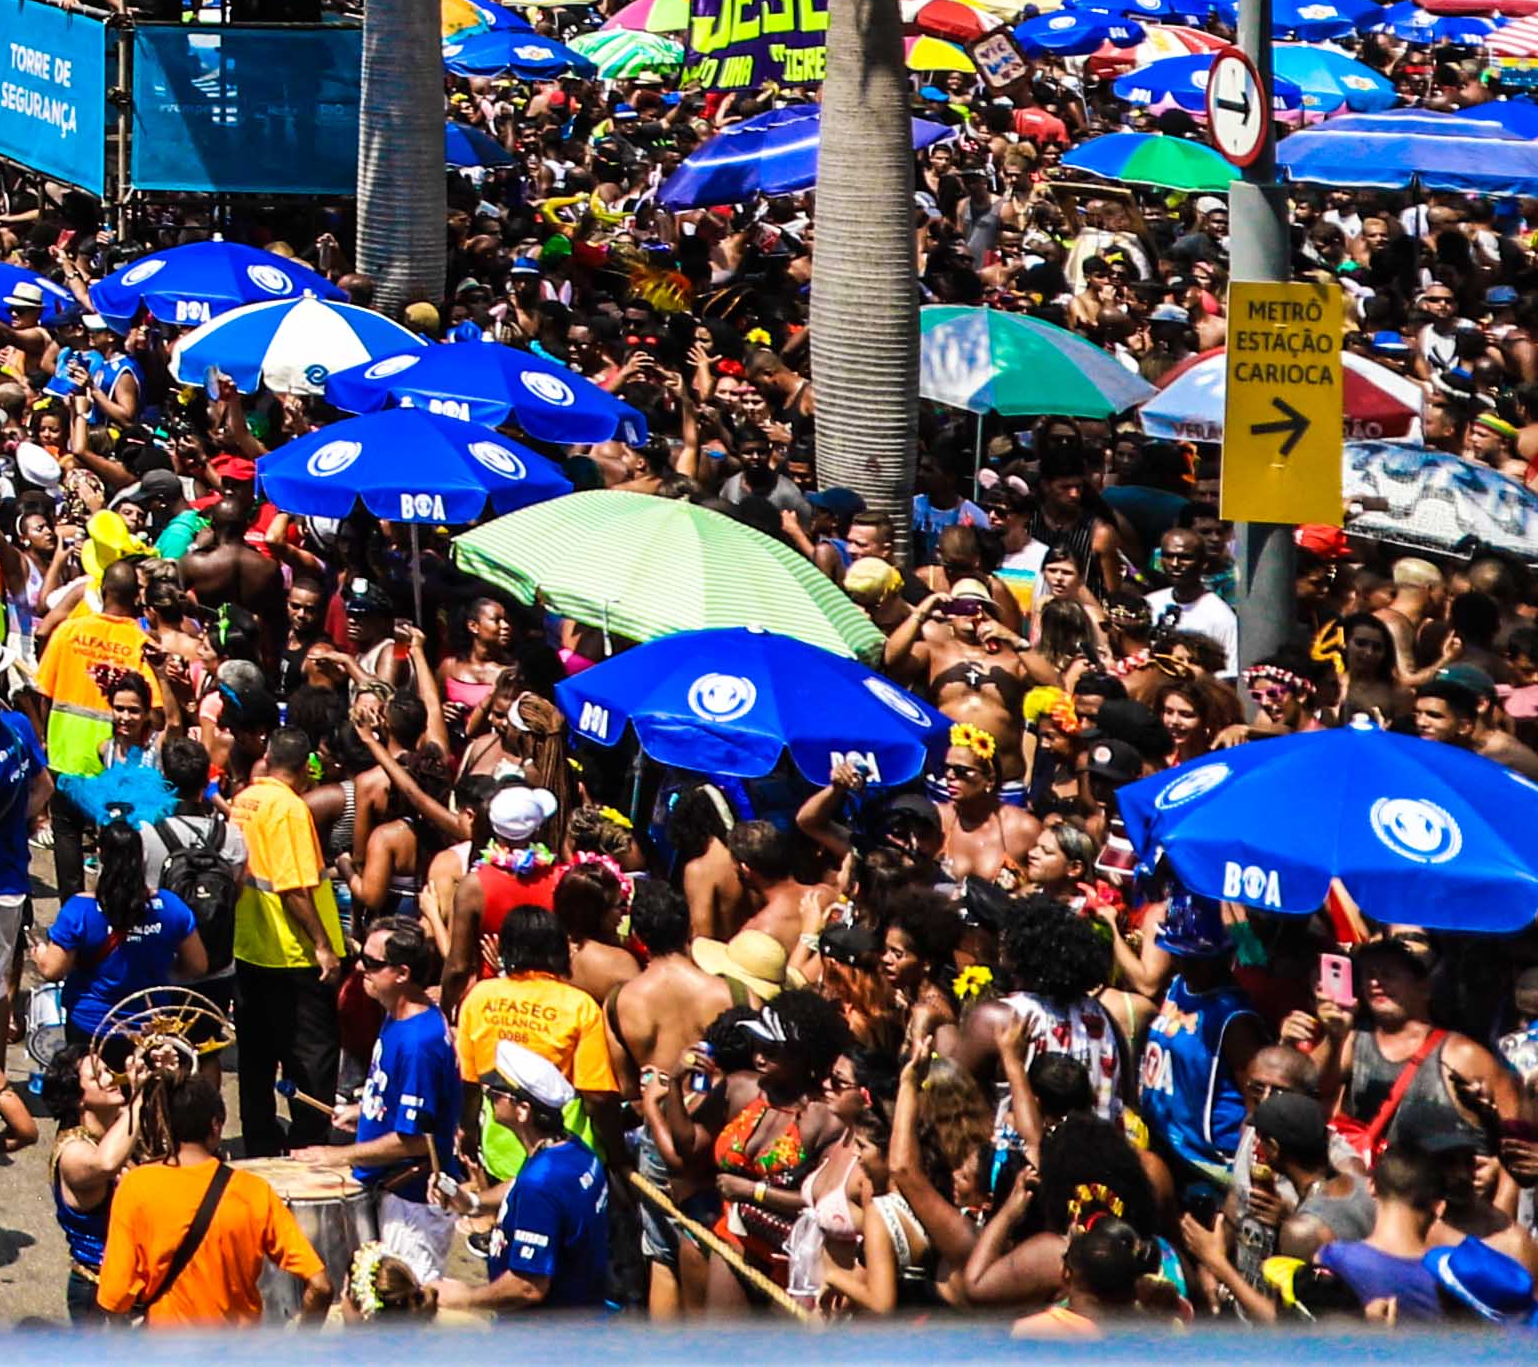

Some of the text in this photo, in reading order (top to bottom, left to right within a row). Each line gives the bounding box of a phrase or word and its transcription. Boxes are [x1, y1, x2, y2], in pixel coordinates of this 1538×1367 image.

[10, 43, 72, 88] TORRE DE
[718, 55, 753, 89] UMA
[1, 81, 77, 138] SEGURANÇA
[176, 301, 212, 323] BOA
[1248, 298, 1323, 324] METRÔ
[1236, 329, 1334, 358] ESTAÇÃO
[1234, 362, 1334, 386] CARIOCA
[401, 494, 445, 521] BOA
[71, 634, 133, 657] ALFASEG
[579, 702, 608, 738] BOA
[1223, 862, 1282, 907] BOA
[482, 998, 559, 1022] ALFASEG
